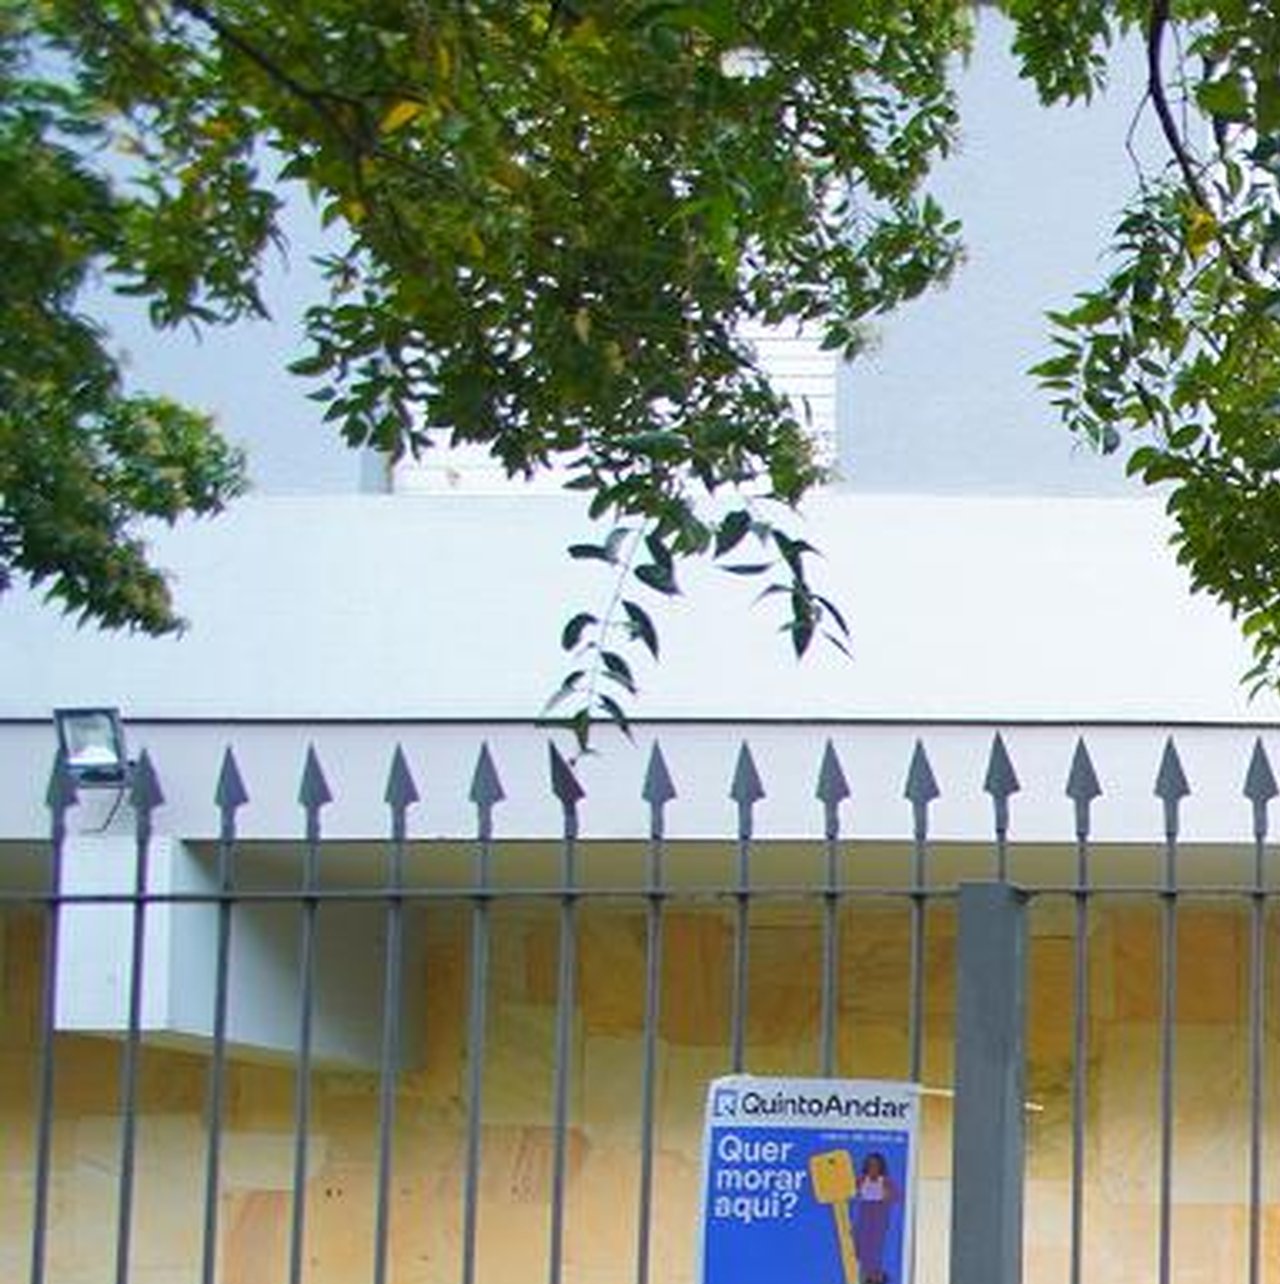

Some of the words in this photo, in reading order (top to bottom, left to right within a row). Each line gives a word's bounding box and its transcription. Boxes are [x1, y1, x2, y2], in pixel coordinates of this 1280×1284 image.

[741, 1091, 910, 1119] QuintoAndar
[718, 1134, 794, 1163] Quer
[717, 1168, 807, 1191] morar
[714, 1191, 799, 1224] aqui?
